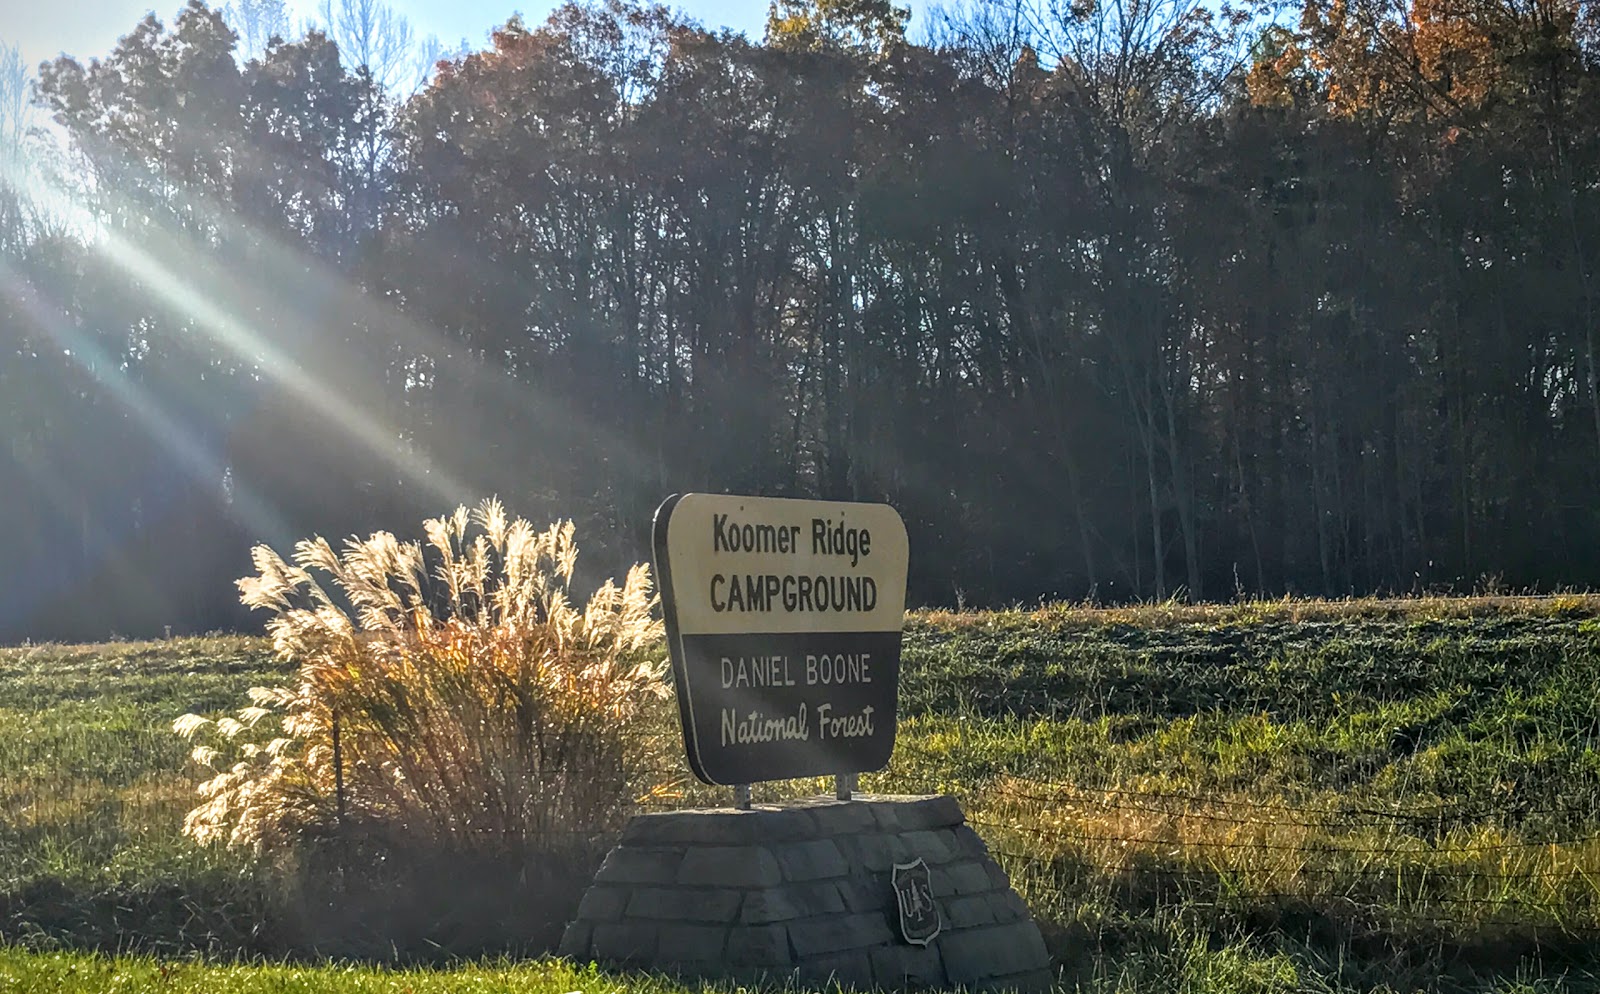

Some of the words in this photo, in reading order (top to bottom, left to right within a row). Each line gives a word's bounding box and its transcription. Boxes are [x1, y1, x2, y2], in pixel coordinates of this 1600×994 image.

[713, 513, 801, 554] Koomer
[811, 518, 871, 567] Ridge
[710, 573, 877, 613] CAMPGROUND
[720, 655, 796, 689] DANIEL
[806, 653, 872, 686] BOONE
[721, 702, 810, 748] National
[817, 703, 875, 740] Forest
